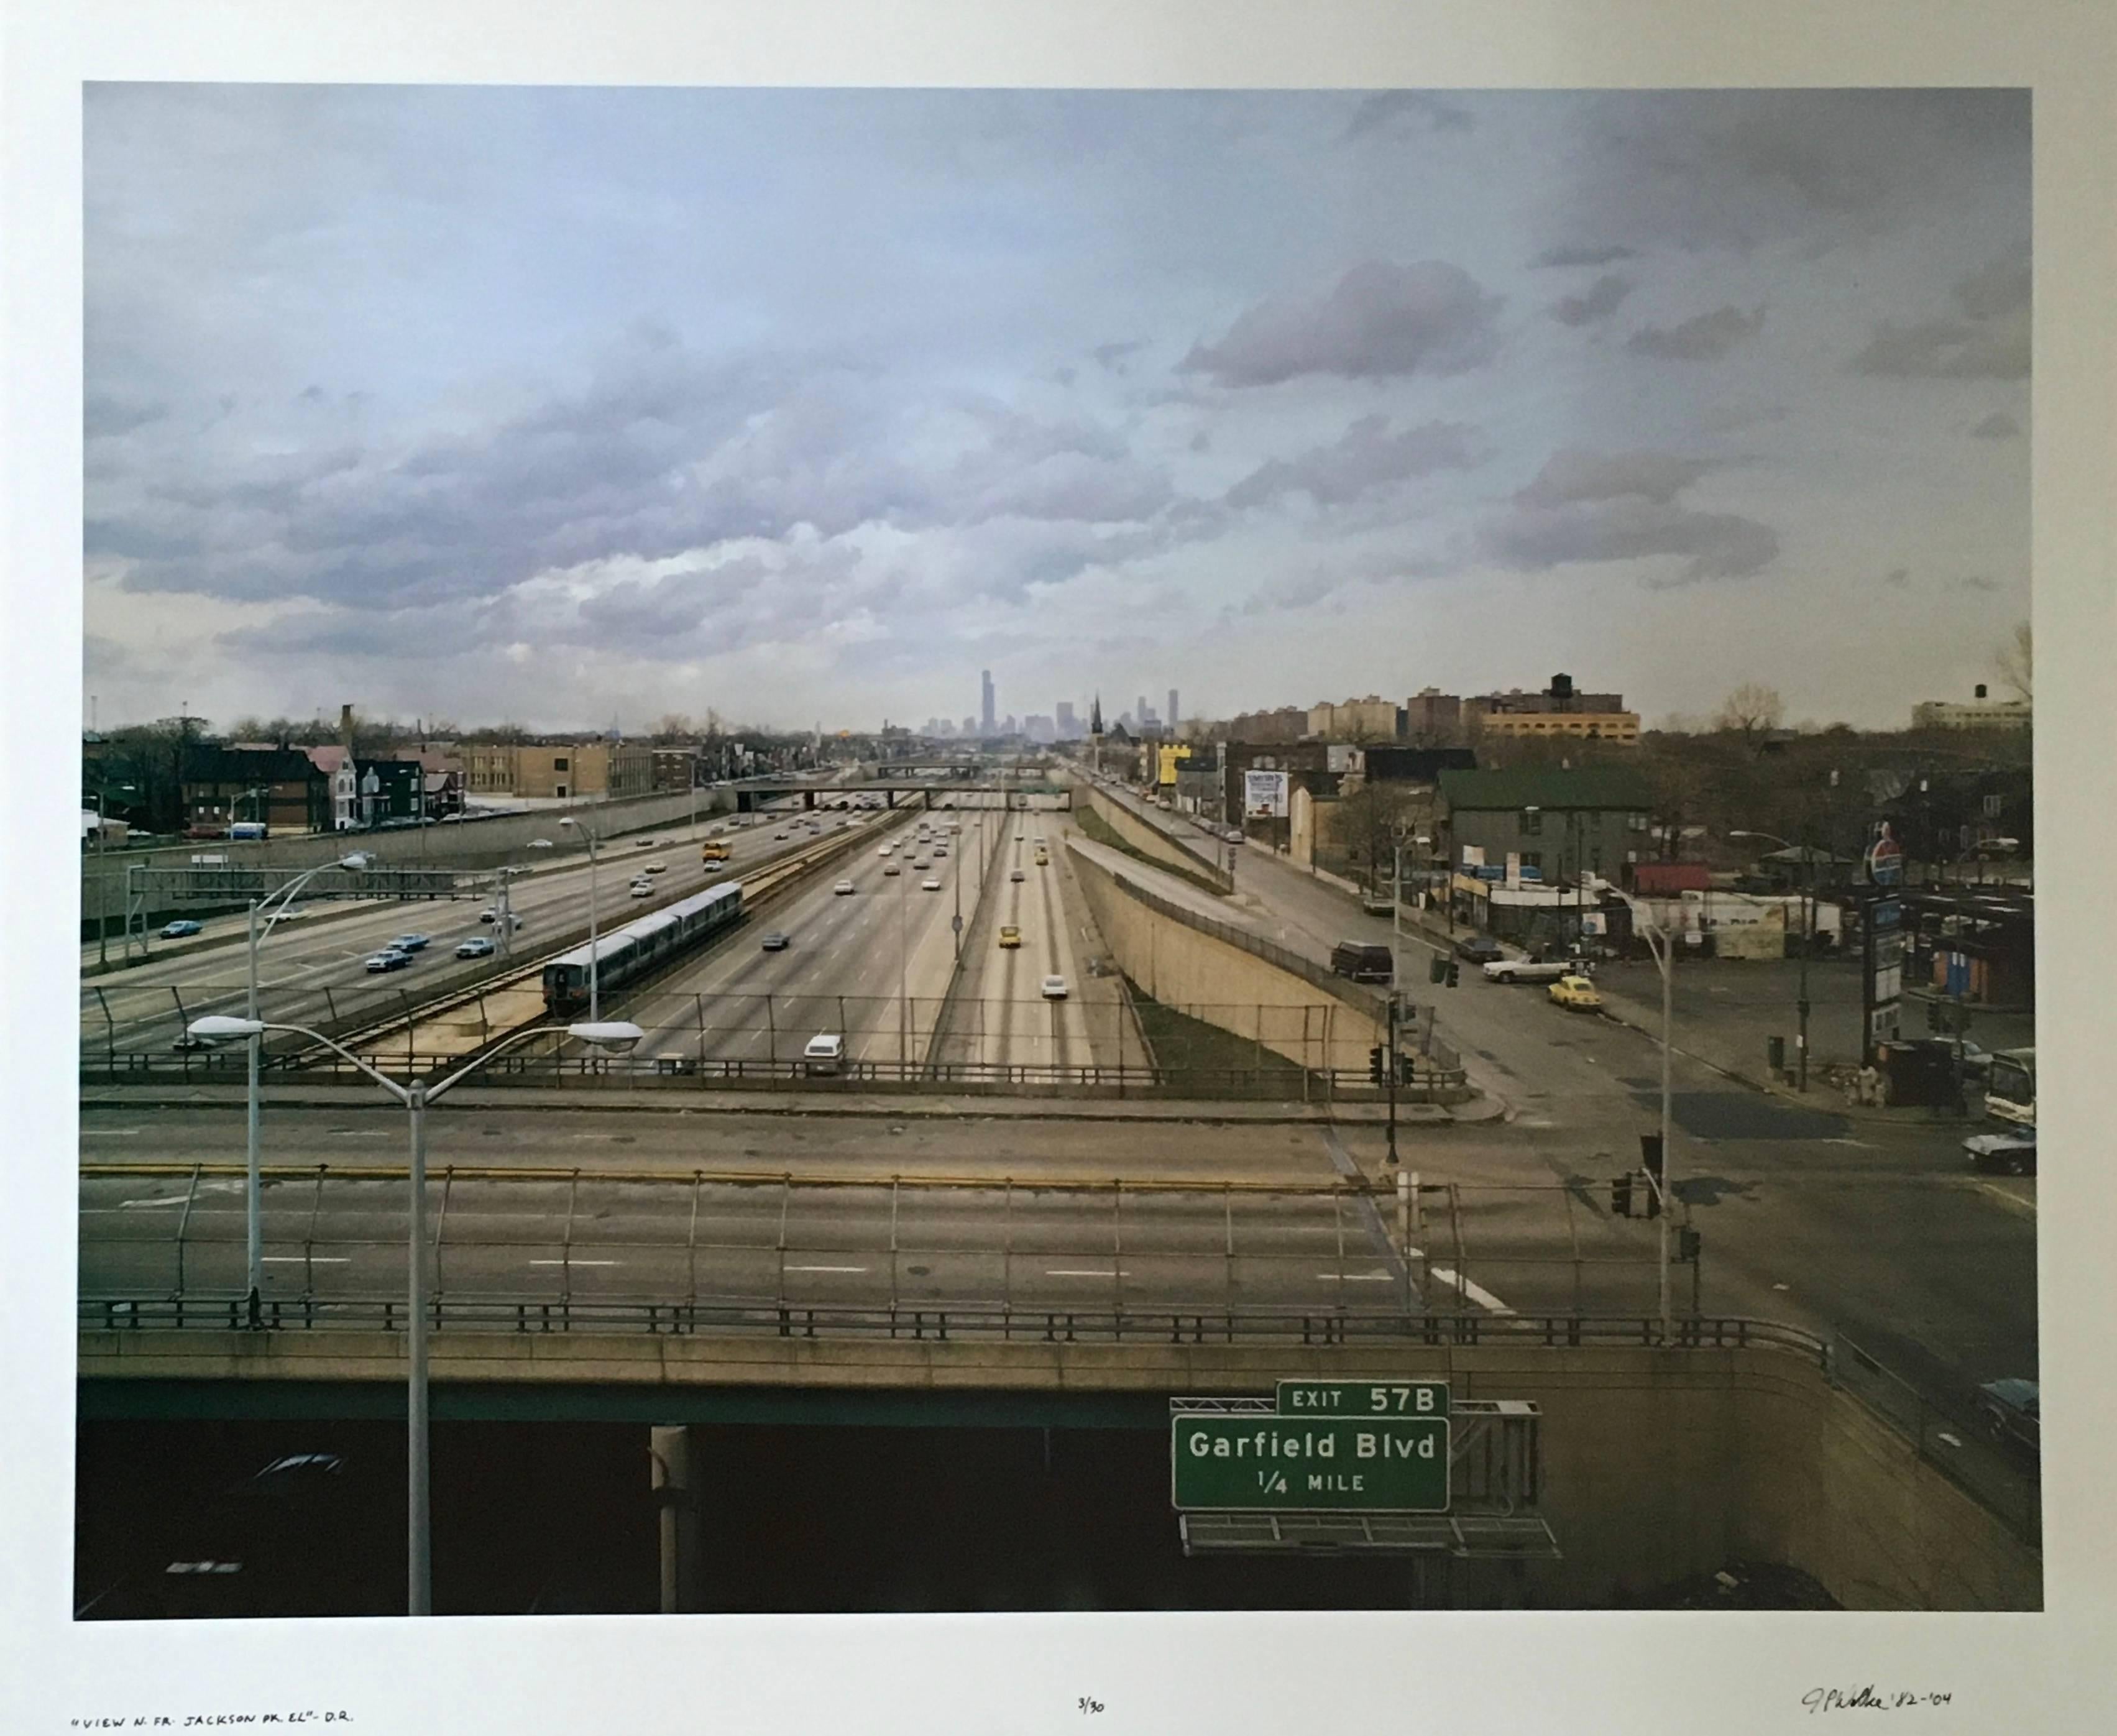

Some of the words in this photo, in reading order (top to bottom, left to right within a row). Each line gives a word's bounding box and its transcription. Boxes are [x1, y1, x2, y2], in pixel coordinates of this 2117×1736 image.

[1292, 1390, 1341, 1407] EXIT
[1371, 1388, 1435, 1412] 57B
[1190, 1431, 1334, 1458] Garfield
[1357, 1433, 1434, 1458] Blvd
[1257, 1470, 1288, 1494] 1/4
[1308, 1474, 1364, 1491] MILE
[1078, 1696, 1104, 1715] 3/30
[183, 1714, 257, 1727] JACKSON
